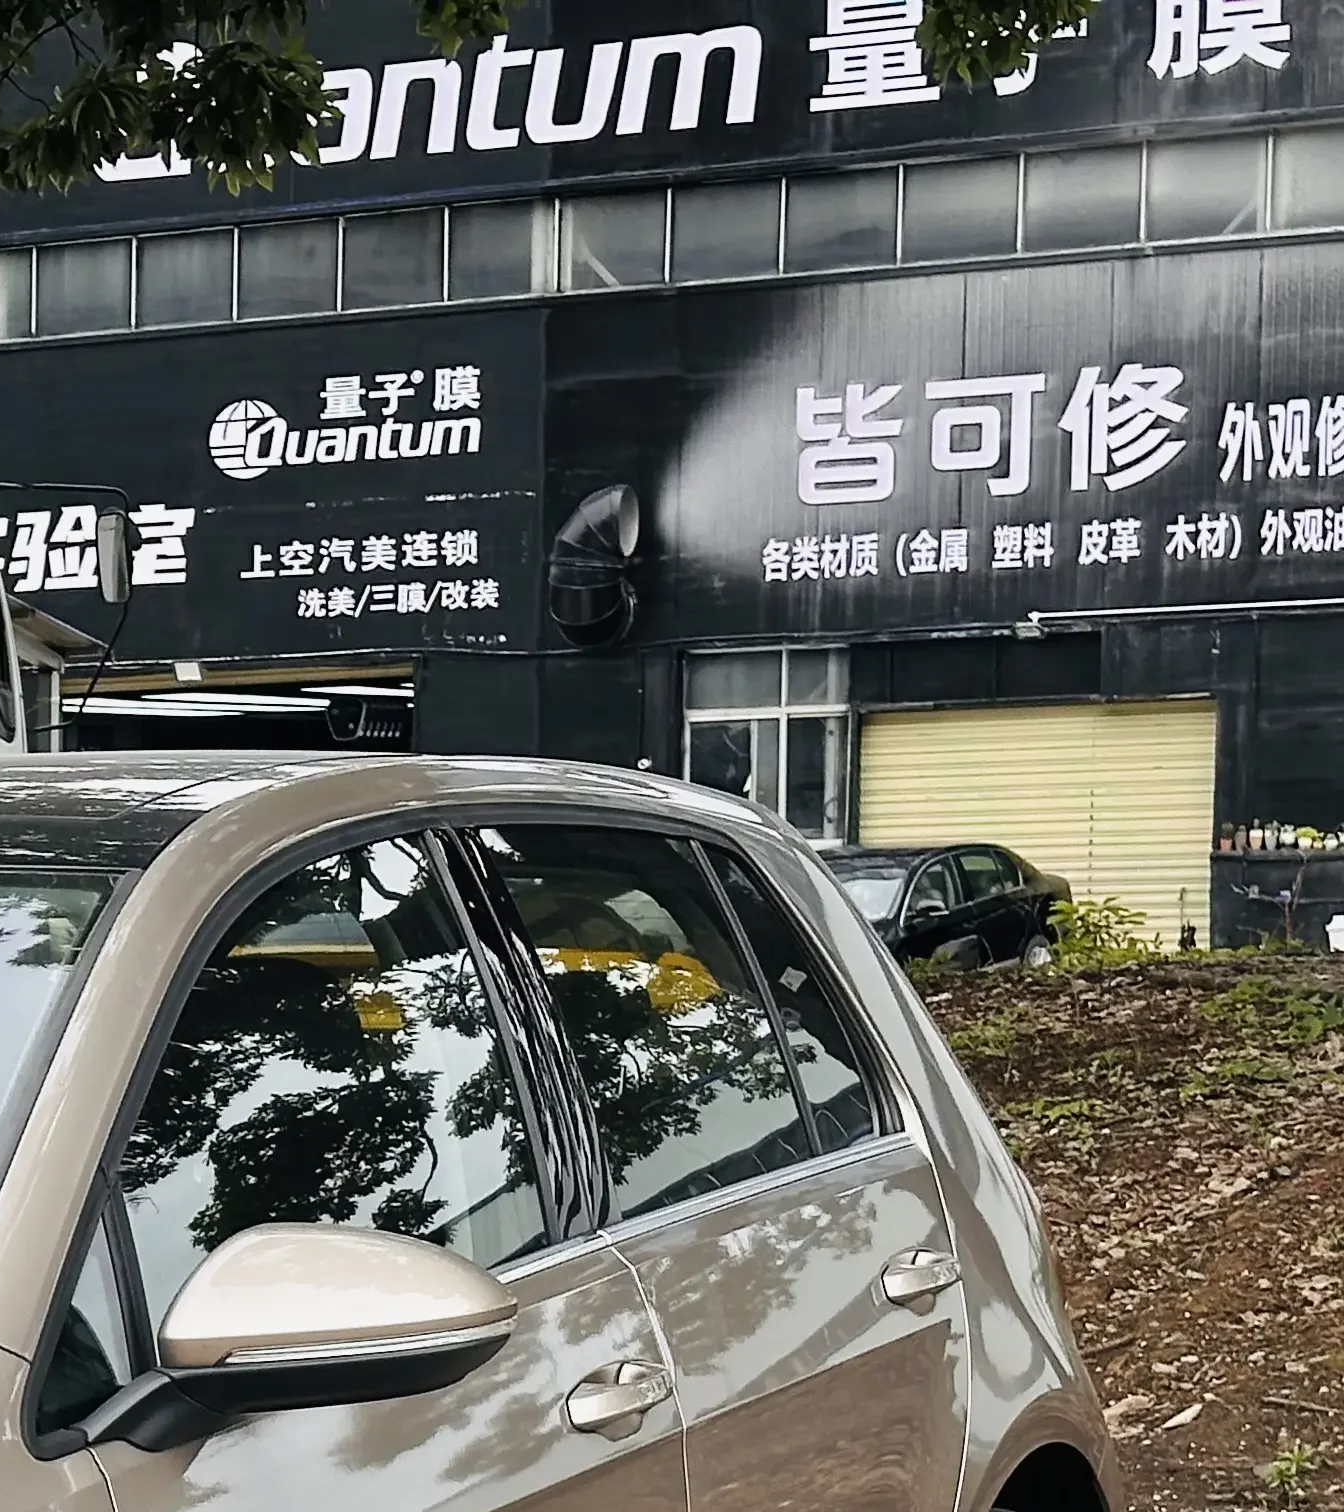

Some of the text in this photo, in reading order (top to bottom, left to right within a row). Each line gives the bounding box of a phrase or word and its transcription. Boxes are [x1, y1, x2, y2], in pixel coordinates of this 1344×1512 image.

[243, 416, 482, 468] Quantum
[796, 364, 1188, 505] 皆可修
[240, 529, 479, 579] 上空汽美连锁
[991, 521, 1055, 570] 塑料
[1078, 517, 1142, 567] 皮革
